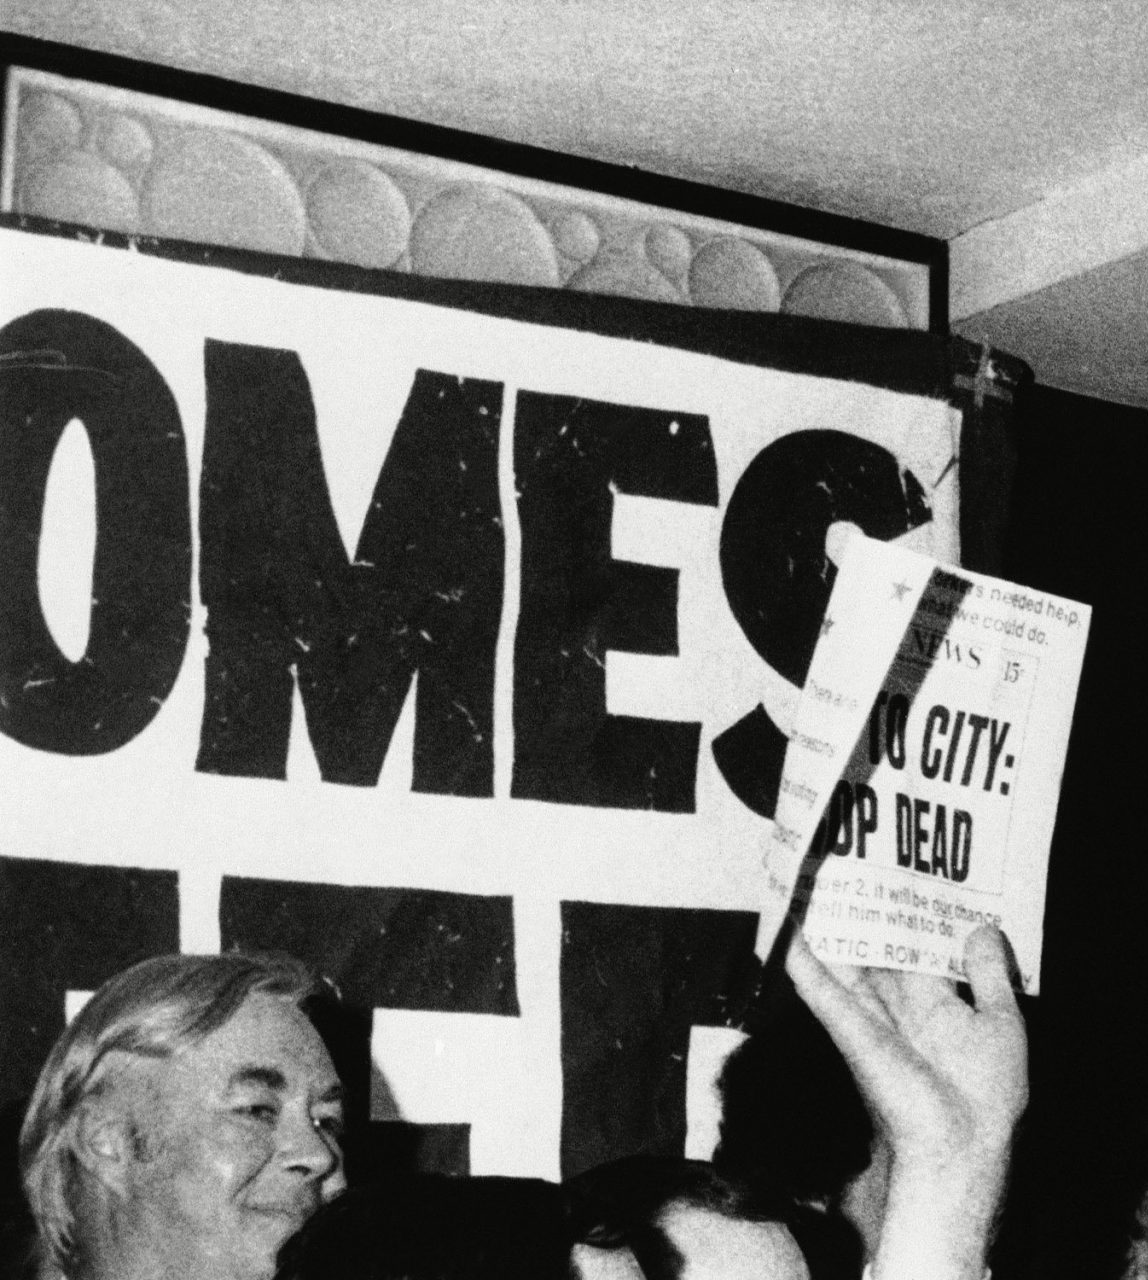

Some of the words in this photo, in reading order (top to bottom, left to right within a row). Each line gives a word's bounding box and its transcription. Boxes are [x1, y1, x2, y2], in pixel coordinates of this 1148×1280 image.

[990, 588, 1043, 615] needed
[983, 615, 1025, 638] could
[1027, 628, 1049, 645] do.
[910, 627, 982, 670] NEWS
[920, 704, 1015, 796] CITY:
[896, 792, 973, 883] DEAD
[885, 944, 919, 964] ROW
